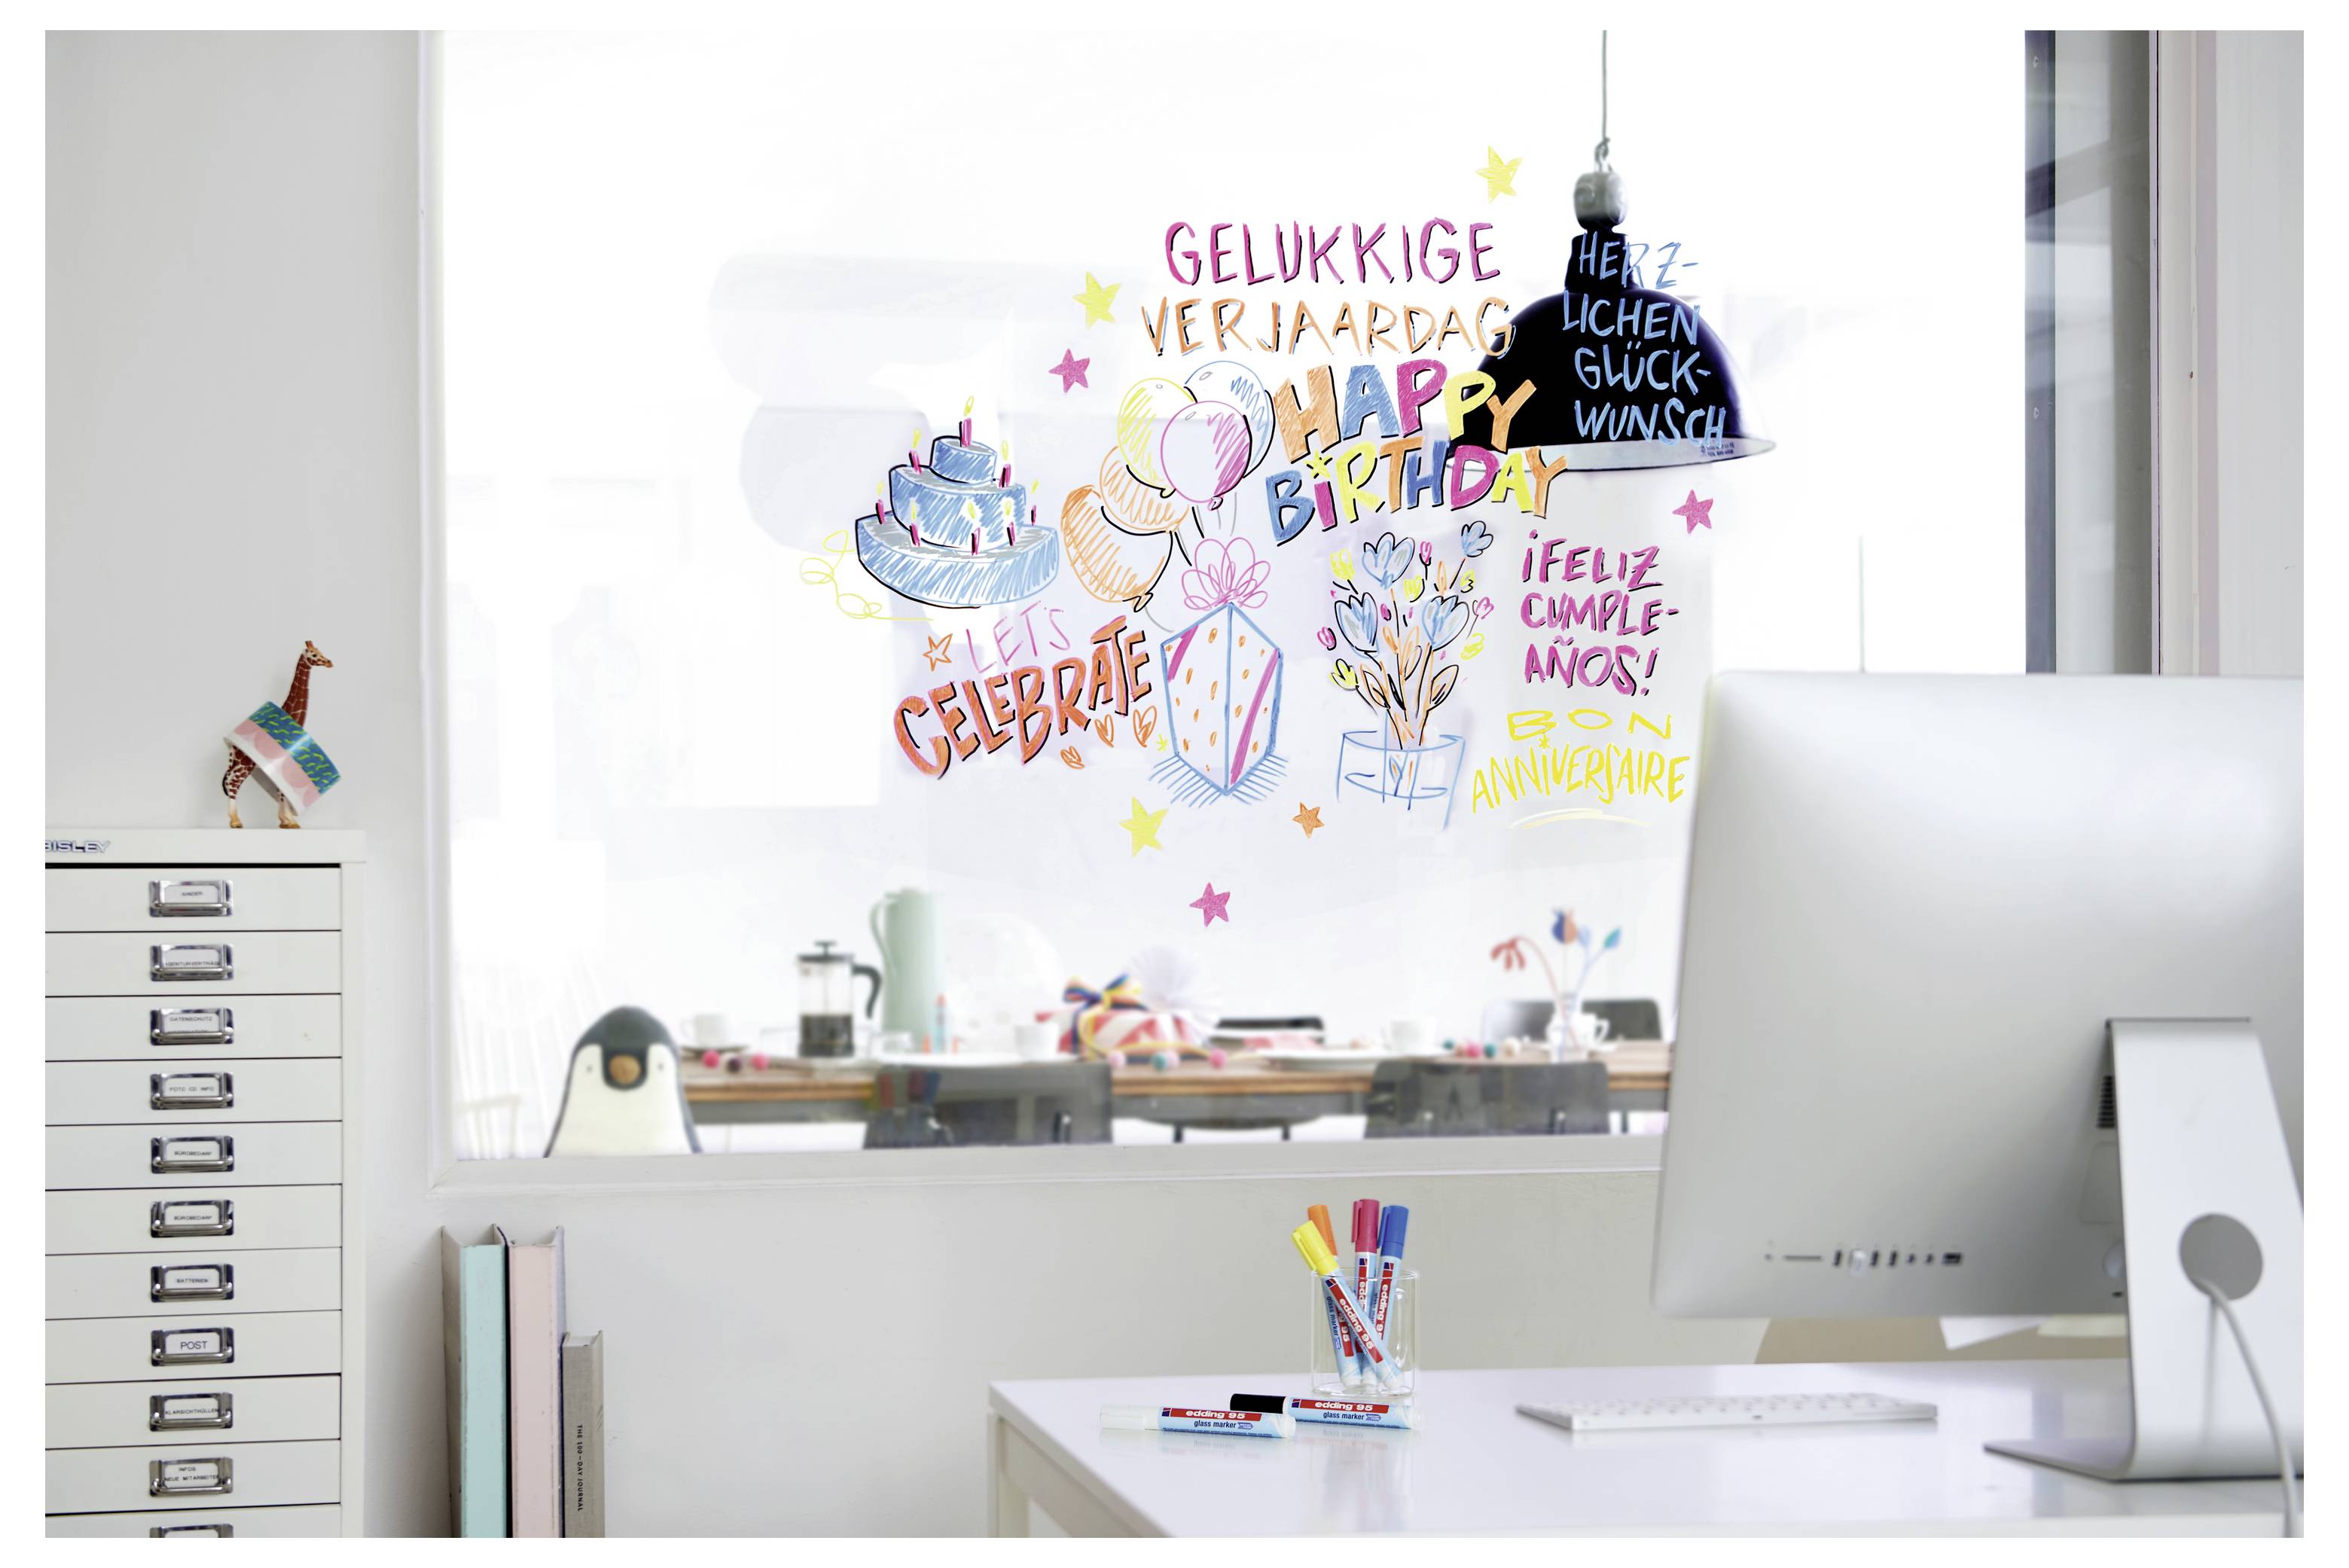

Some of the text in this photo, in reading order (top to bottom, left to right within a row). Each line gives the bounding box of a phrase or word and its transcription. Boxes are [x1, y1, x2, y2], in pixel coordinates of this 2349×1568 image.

[1165, 218, 1501, 285] GELUKKIGE
[1579, 231, 1698, 289] HERZ-
[1141, 297, 1515, 358] VERJAARDAG
[1563, 289, 1700, 345] LICHEN
[1575, 340, 1711, 395] GLÜCK-
[1274, 358, 1538, 459] HAPPY
[1574, 397, 1726, 448] WUNSCH
[1521, 590, 1679, 637] CUMPLE-
[1524, 636, 1660, 696] AÑOS!
[894, 615, 1152, 779] CELEBRATE
[1507, 709, 1672, 741] BON
[1472, 740, 1690, 813] ANNIVERSAIRE
[1339, 1298, 1363, 1332] edding
[1361, 1332, 1375, 1350] 95
[1377, 1284, 1389, 1321] edding
[181, 1341, 208, 1350] POST
[1341, 1325, 1350, 1342] 95
[1186, 1410, 1225, 1419] edding
[1194, 1420, 1236, 1429] glass marker
[1315, 1402, 1353, 1410] edding
[1342, 1412, 1364, 1420] marker
